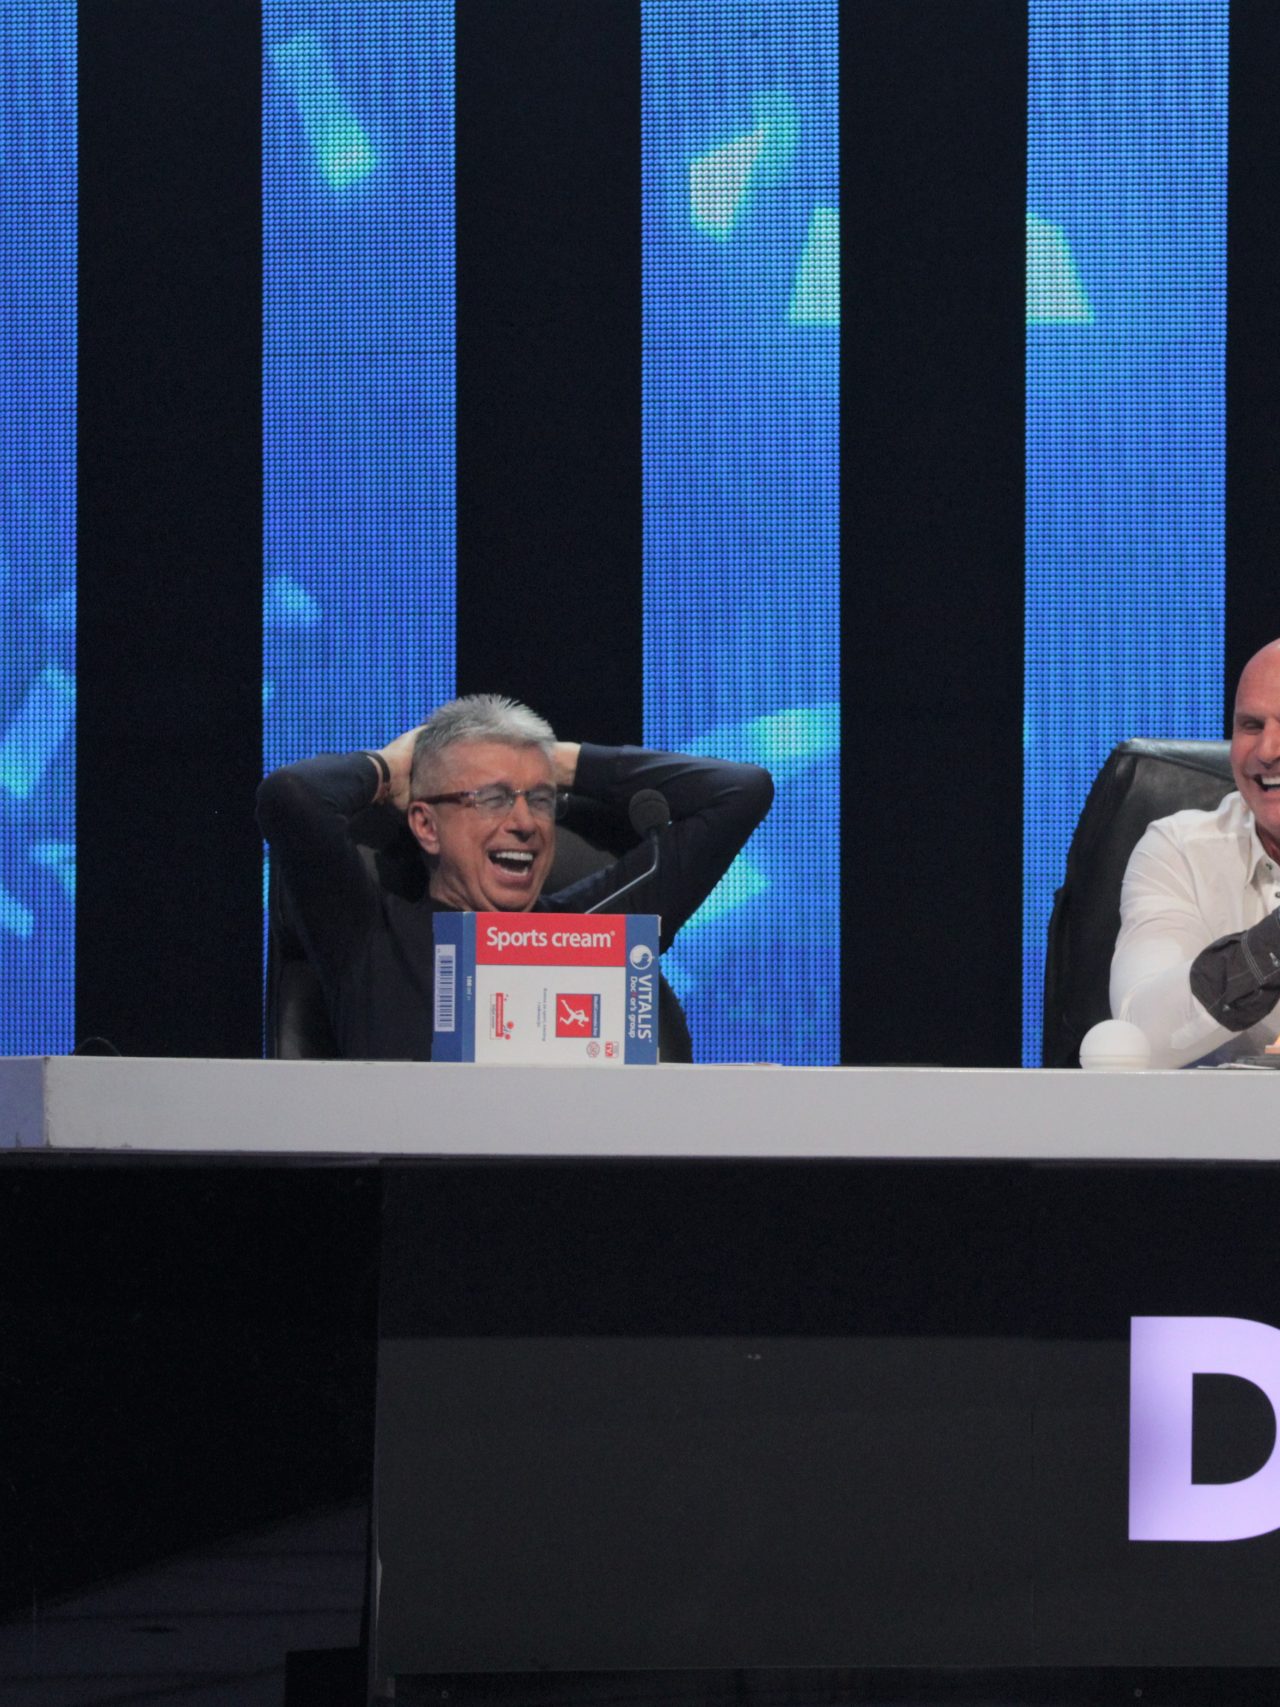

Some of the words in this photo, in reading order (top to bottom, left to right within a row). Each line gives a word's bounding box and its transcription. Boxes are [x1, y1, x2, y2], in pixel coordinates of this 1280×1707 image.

[486, 926, 548, 951] Sports
[551, 930, 612, 948] cream
[637, 973, 653, 1040] VITALIS
[628, 1013, 637, 1039] group
